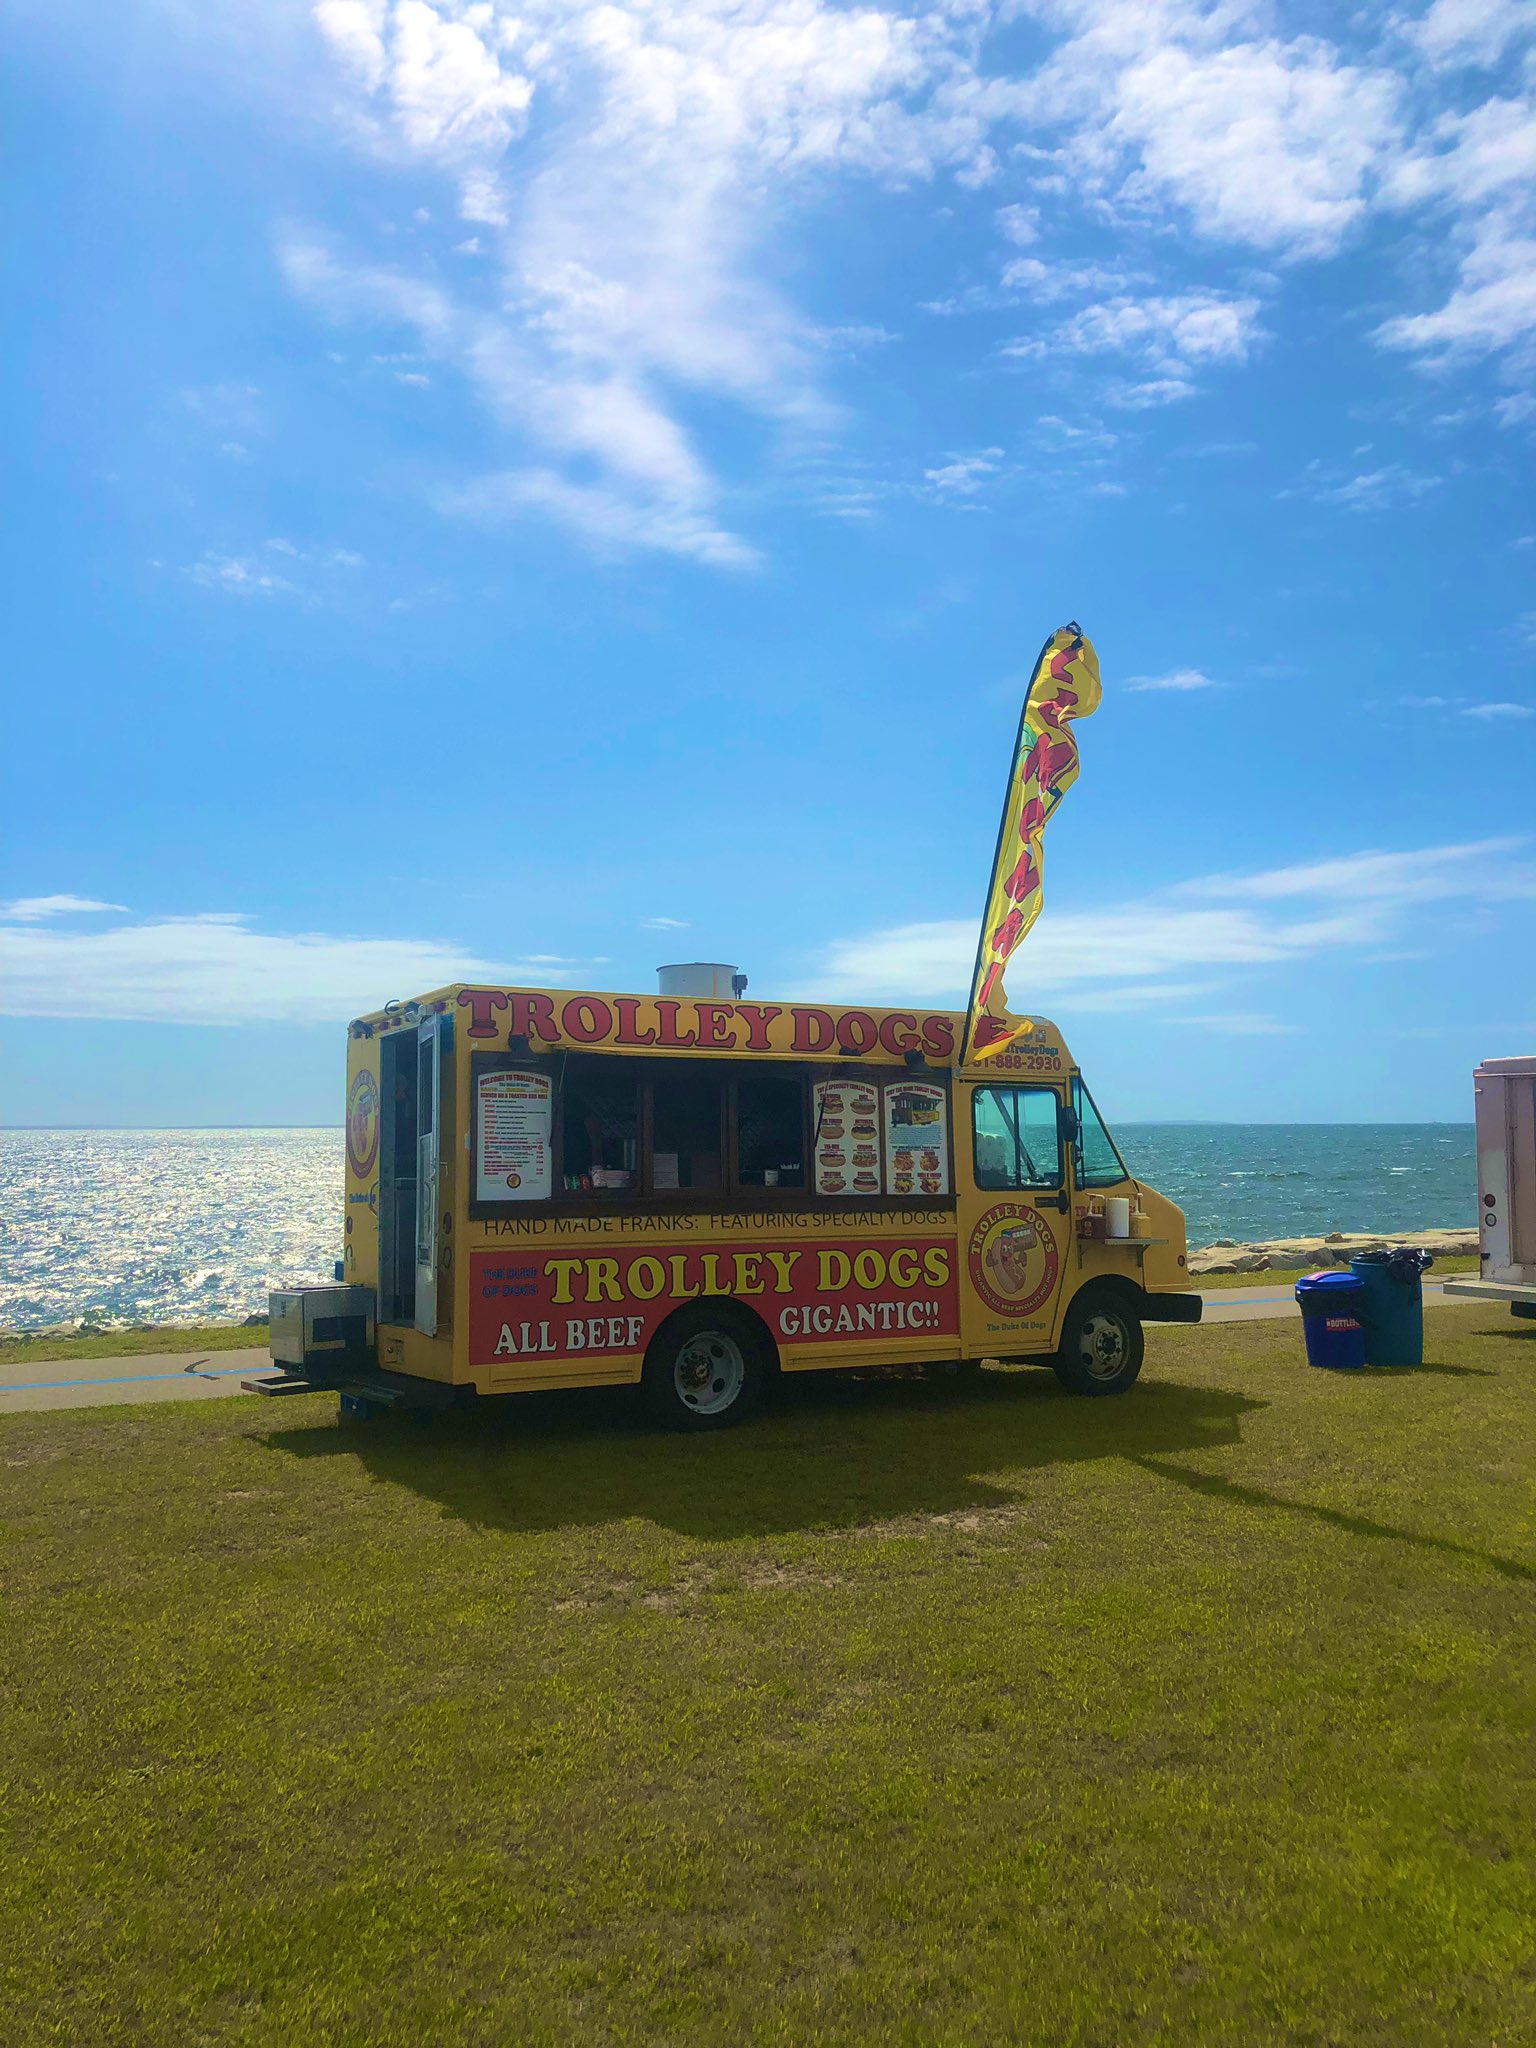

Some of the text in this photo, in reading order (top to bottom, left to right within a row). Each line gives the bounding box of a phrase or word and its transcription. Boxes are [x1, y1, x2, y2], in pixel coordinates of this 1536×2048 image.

[456, 989, 954, 1057] TROLLEY DOGS
[973, 1054, 1062, 1071] 1-888-2930
[484, 1210, 947, 1236] HAND MADE FRANKS: FEATURING SPECIALTY DOGS
[971, 1205, 1054, 1255] TROLLEY DOGS
[543, 1246, 950, 1304] TROLLEY DOGS
[493, 1315, 646, 1356] ALL BEEF
[779, 1300, 940, 1336] GIGANTIC!!
